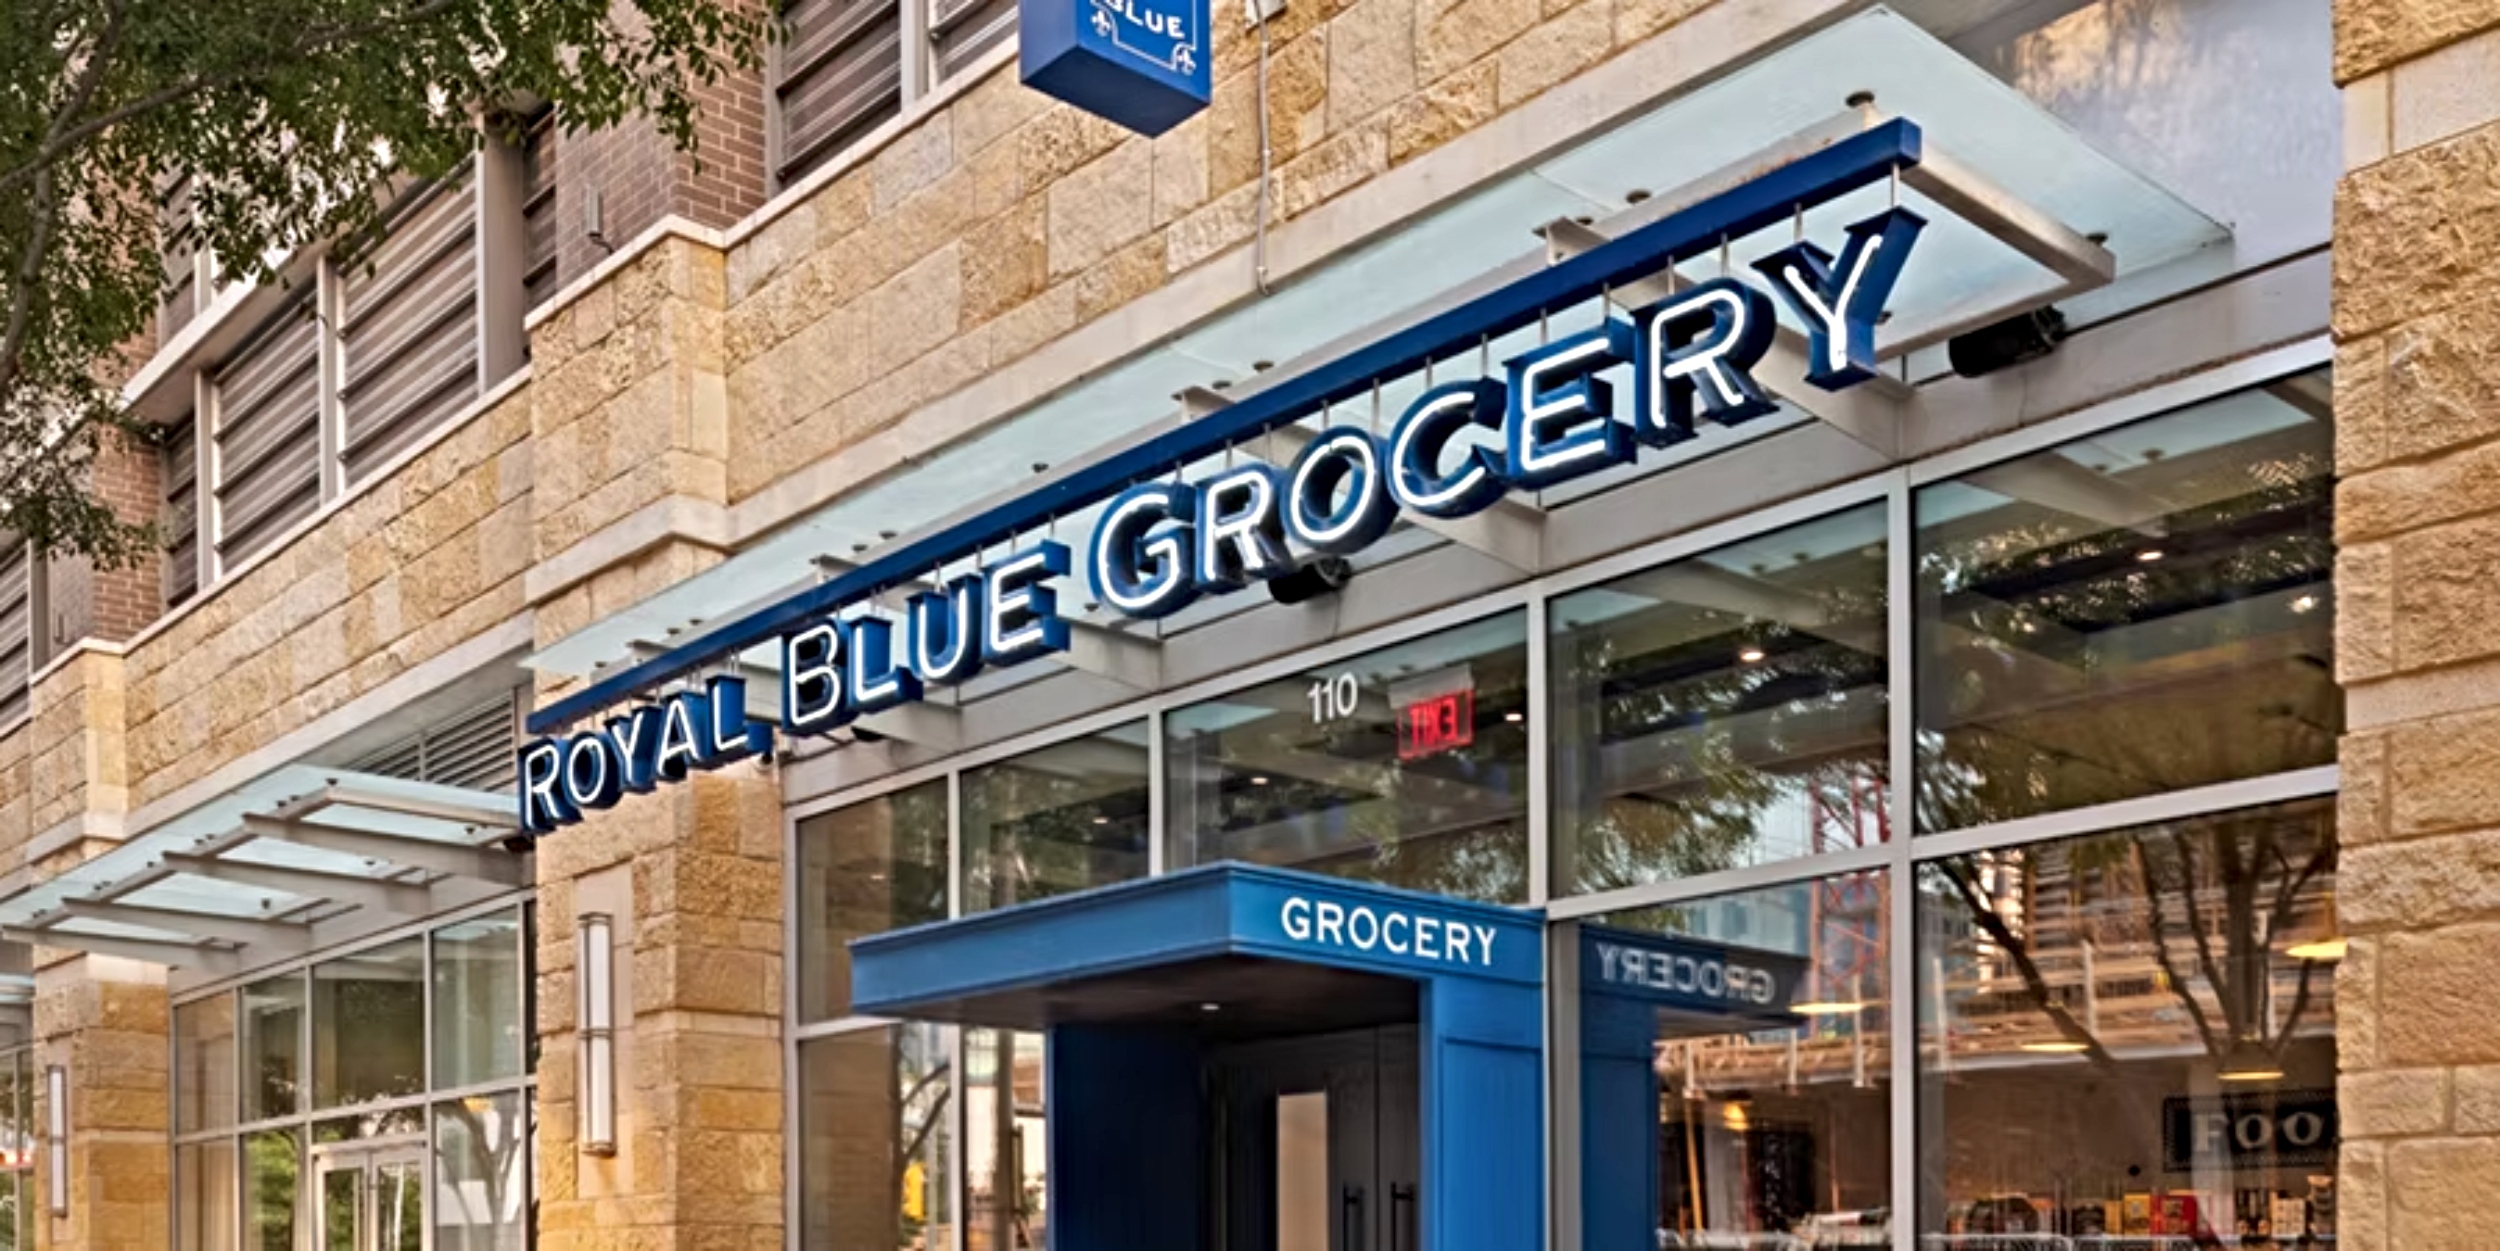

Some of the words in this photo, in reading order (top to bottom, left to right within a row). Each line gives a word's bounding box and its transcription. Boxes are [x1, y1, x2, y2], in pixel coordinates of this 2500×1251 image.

[518, 674, 773, 835] ROYAL
[782, 540, 1071, 736] BLUE
[1088, 206, 1928, 619] GROCERY
[1307, 671, 1359, 724] 110
[1281, 897, 1498, 966] GROCERY
[2194, 1110, 2337, 1149] FOO
